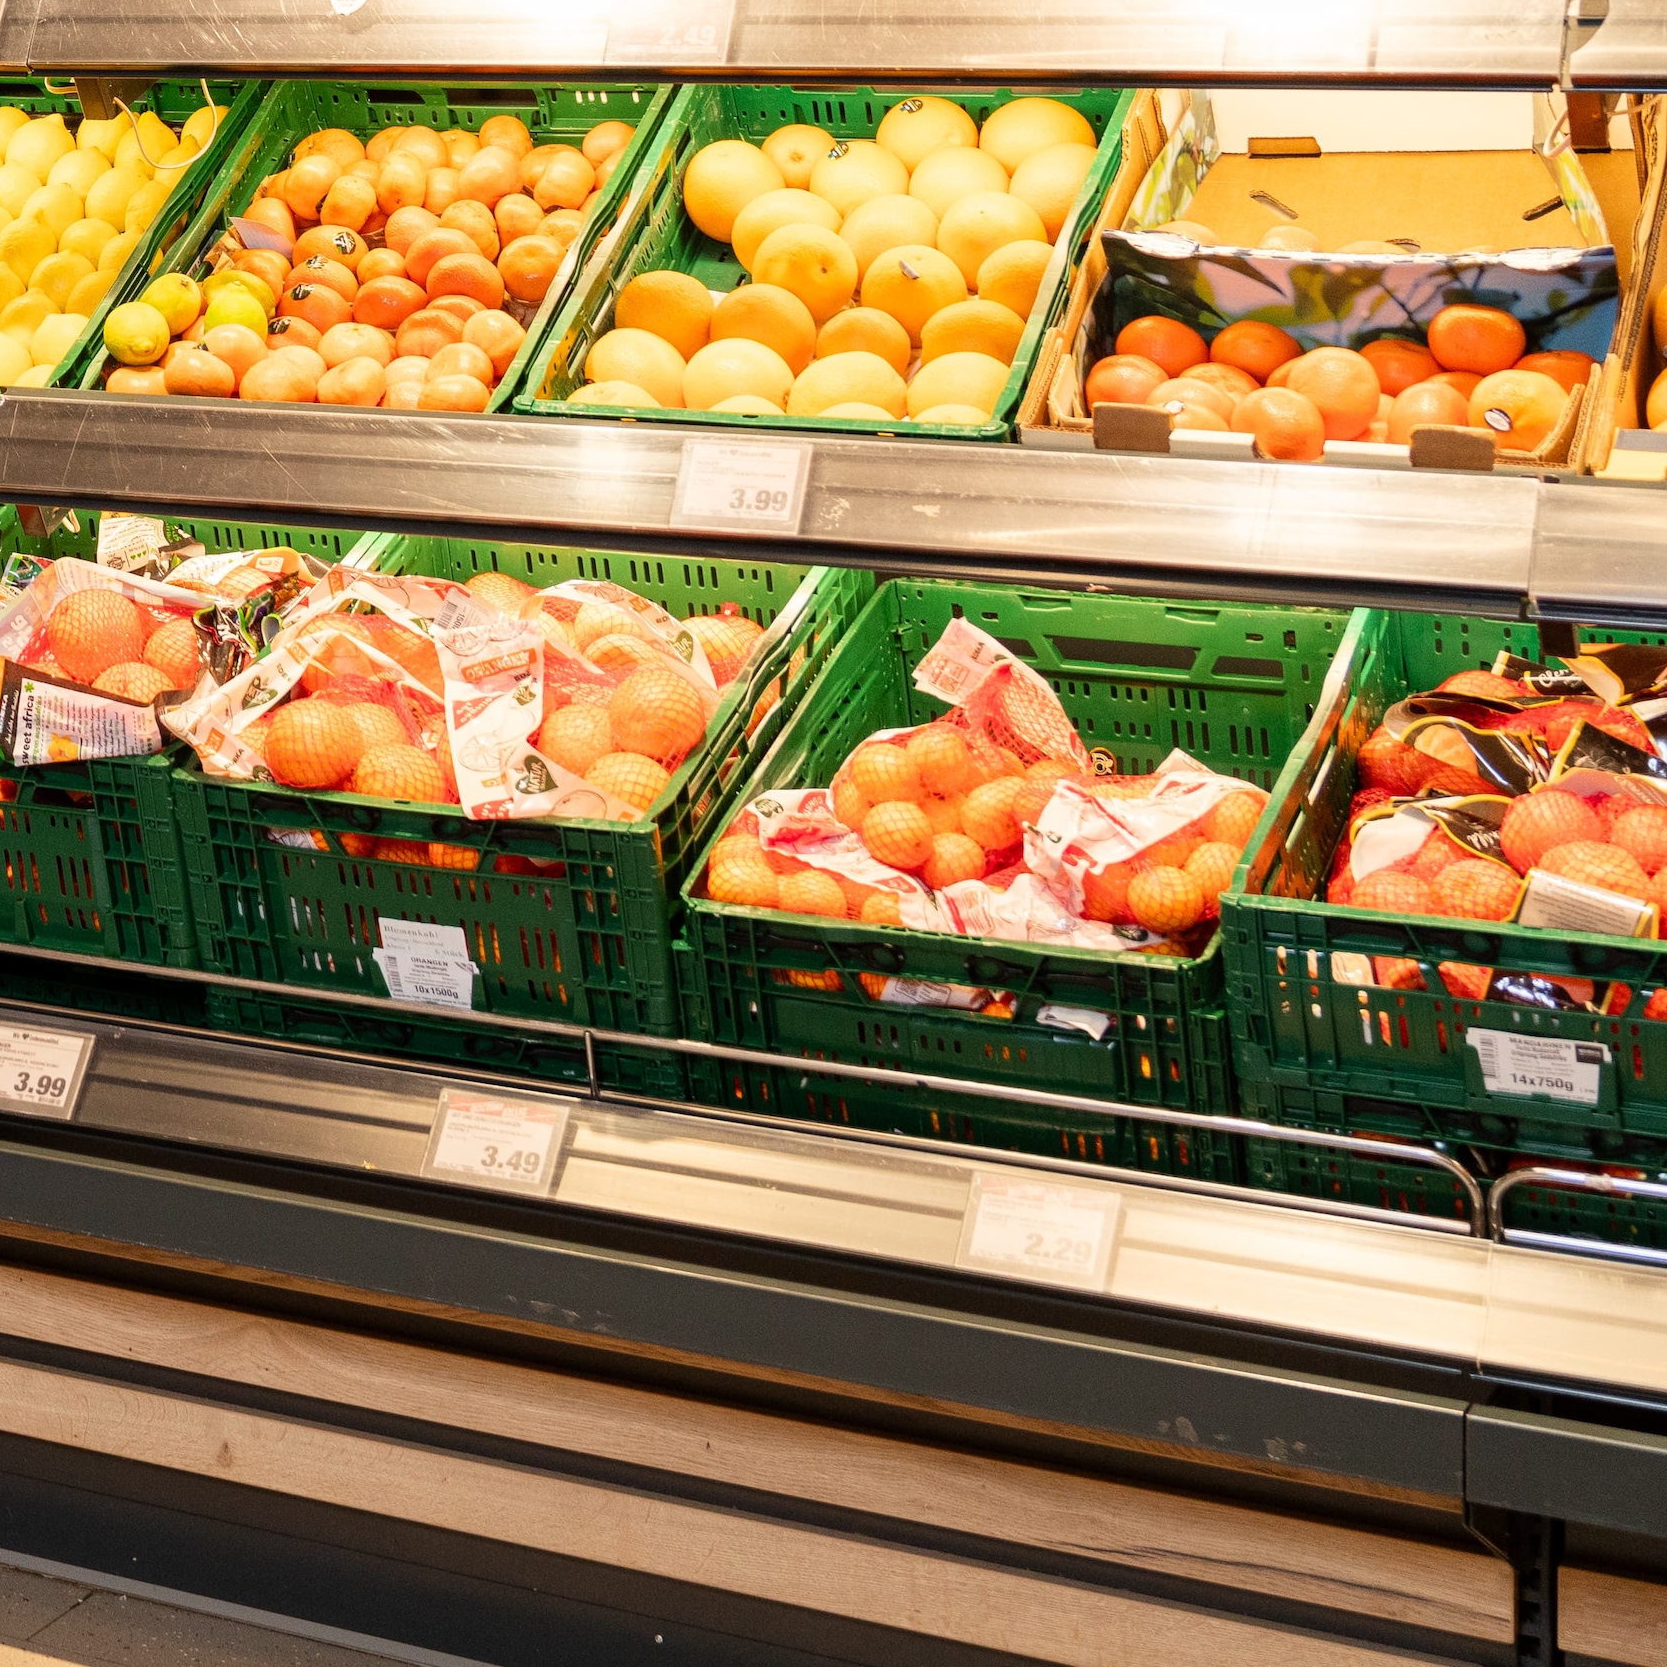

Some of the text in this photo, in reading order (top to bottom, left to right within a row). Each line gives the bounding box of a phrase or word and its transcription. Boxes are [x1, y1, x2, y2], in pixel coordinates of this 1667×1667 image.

[729, 488, 788, 512] 3.99
[21, 695, 35, 765] sweet africa
[528, 761, 543, 794] NATUR
[384, 925, 439, 939] Blumenkohl
[410, 956, 449, 967] ORANGEN
[414, 984, 459, 999] 10x1500g
[1508, 1036, 1572, 1050] MANDARINEN
[13, 1071, 66, 1098] 3.99
[1509, 1072, 1575, 1092] 14x750g
[480, 1145, 541, 1174] 3.49
[1023, 1232, 1093, 1265] 2.29
